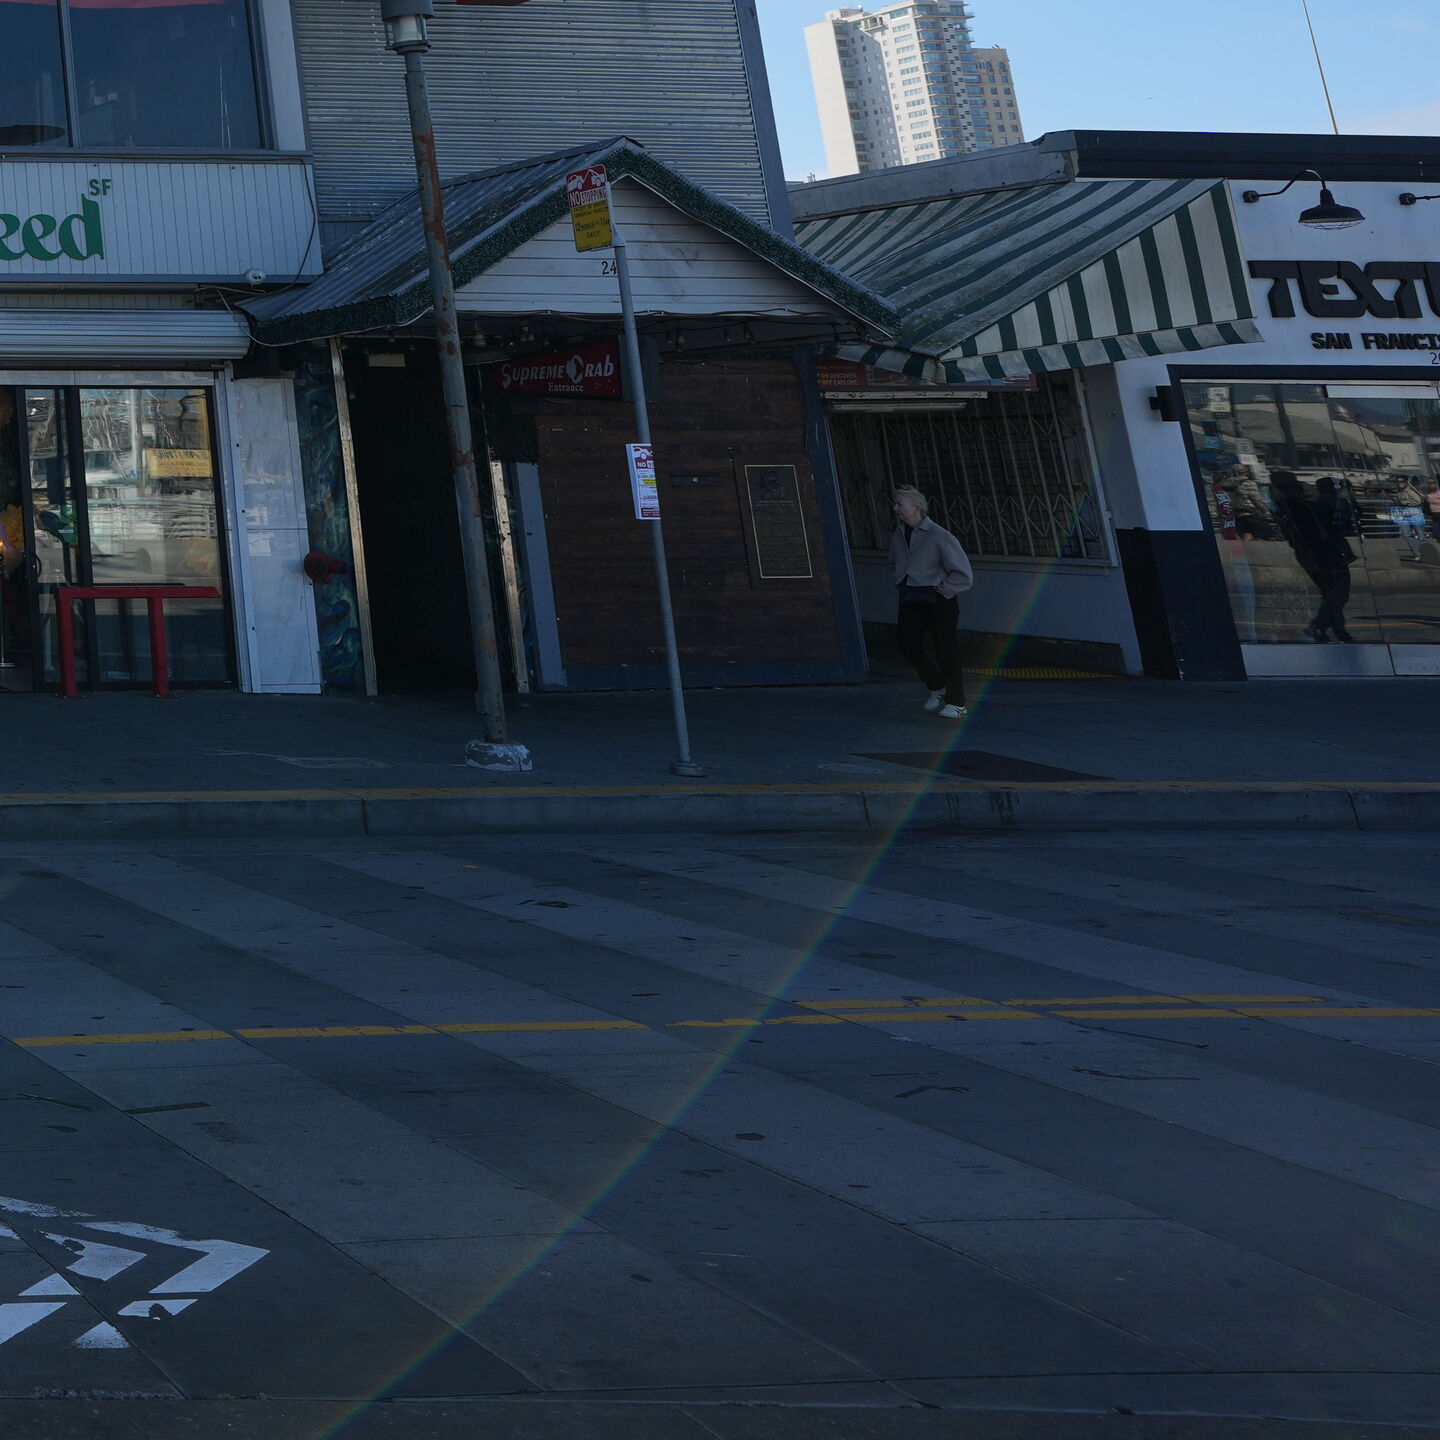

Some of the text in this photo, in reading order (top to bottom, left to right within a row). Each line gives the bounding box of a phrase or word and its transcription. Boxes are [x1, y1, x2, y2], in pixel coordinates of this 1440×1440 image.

[90, 178, 112, 197] SF
[569, 191, 581, 206] NO
[580, 187, 607, 205] STOPPING
[1311, 333, 1352, 350] SAN
[548, 383, 584, 392] Entrance
